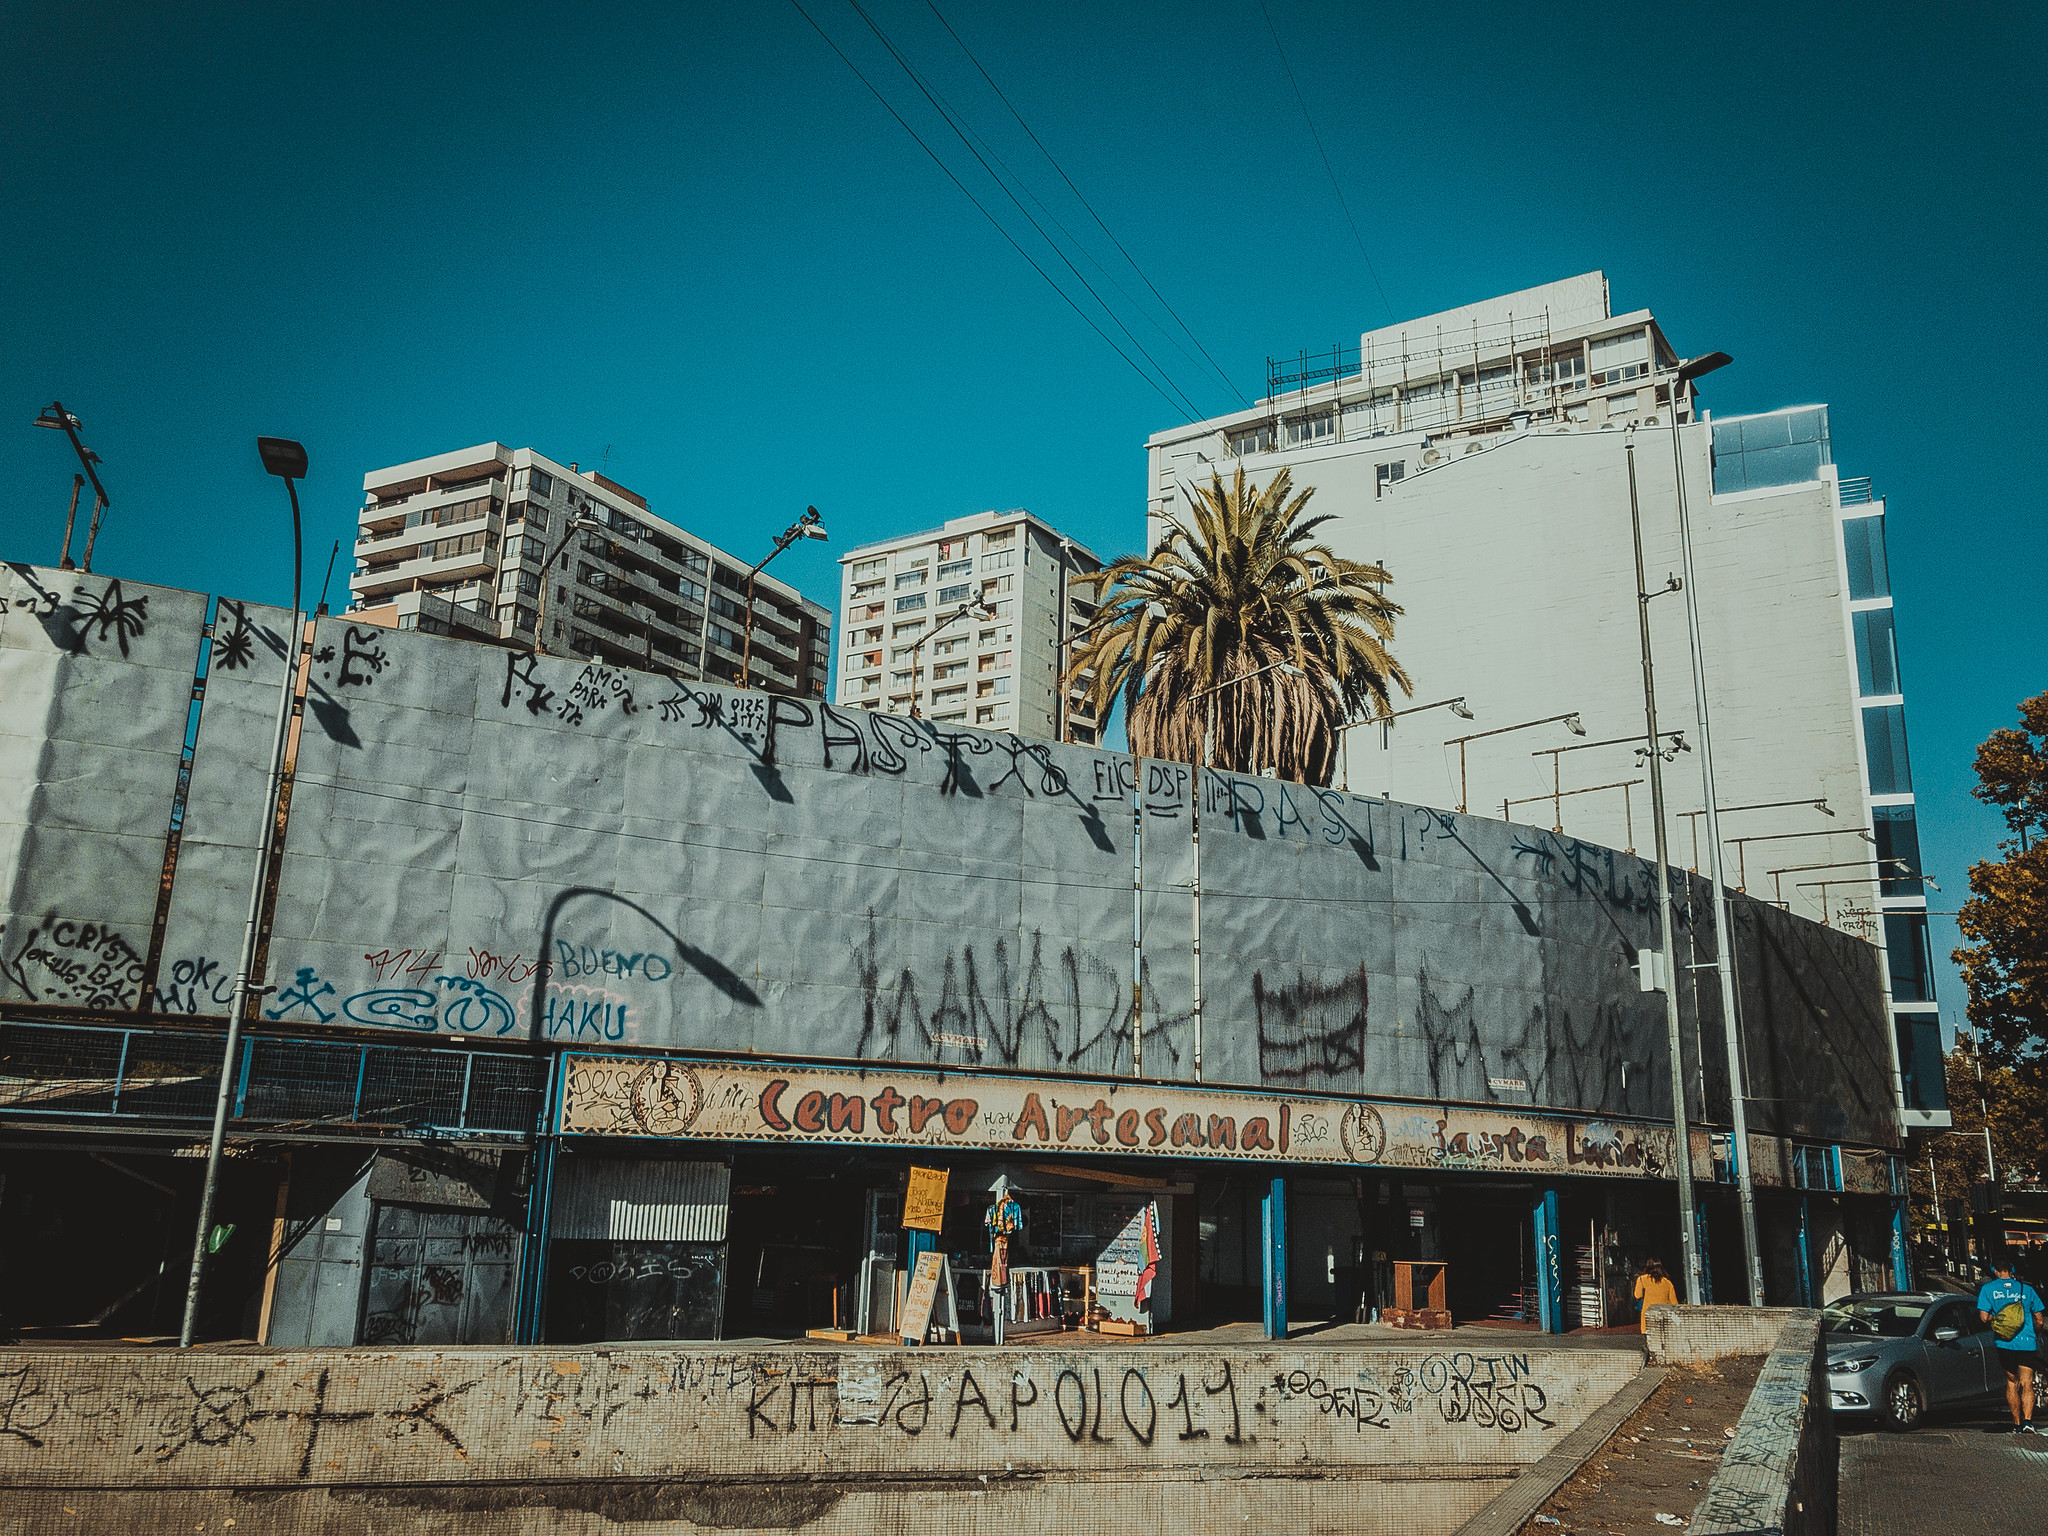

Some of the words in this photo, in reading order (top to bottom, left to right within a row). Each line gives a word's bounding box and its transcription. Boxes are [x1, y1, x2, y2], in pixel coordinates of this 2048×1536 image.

[1148, 765, 1188, 801] DSP
[556, 938, 672, 982] BUENO
[758, 1079, 980, 1136] Centro
[1012, 1091, 1291, 1155] Artesanal
